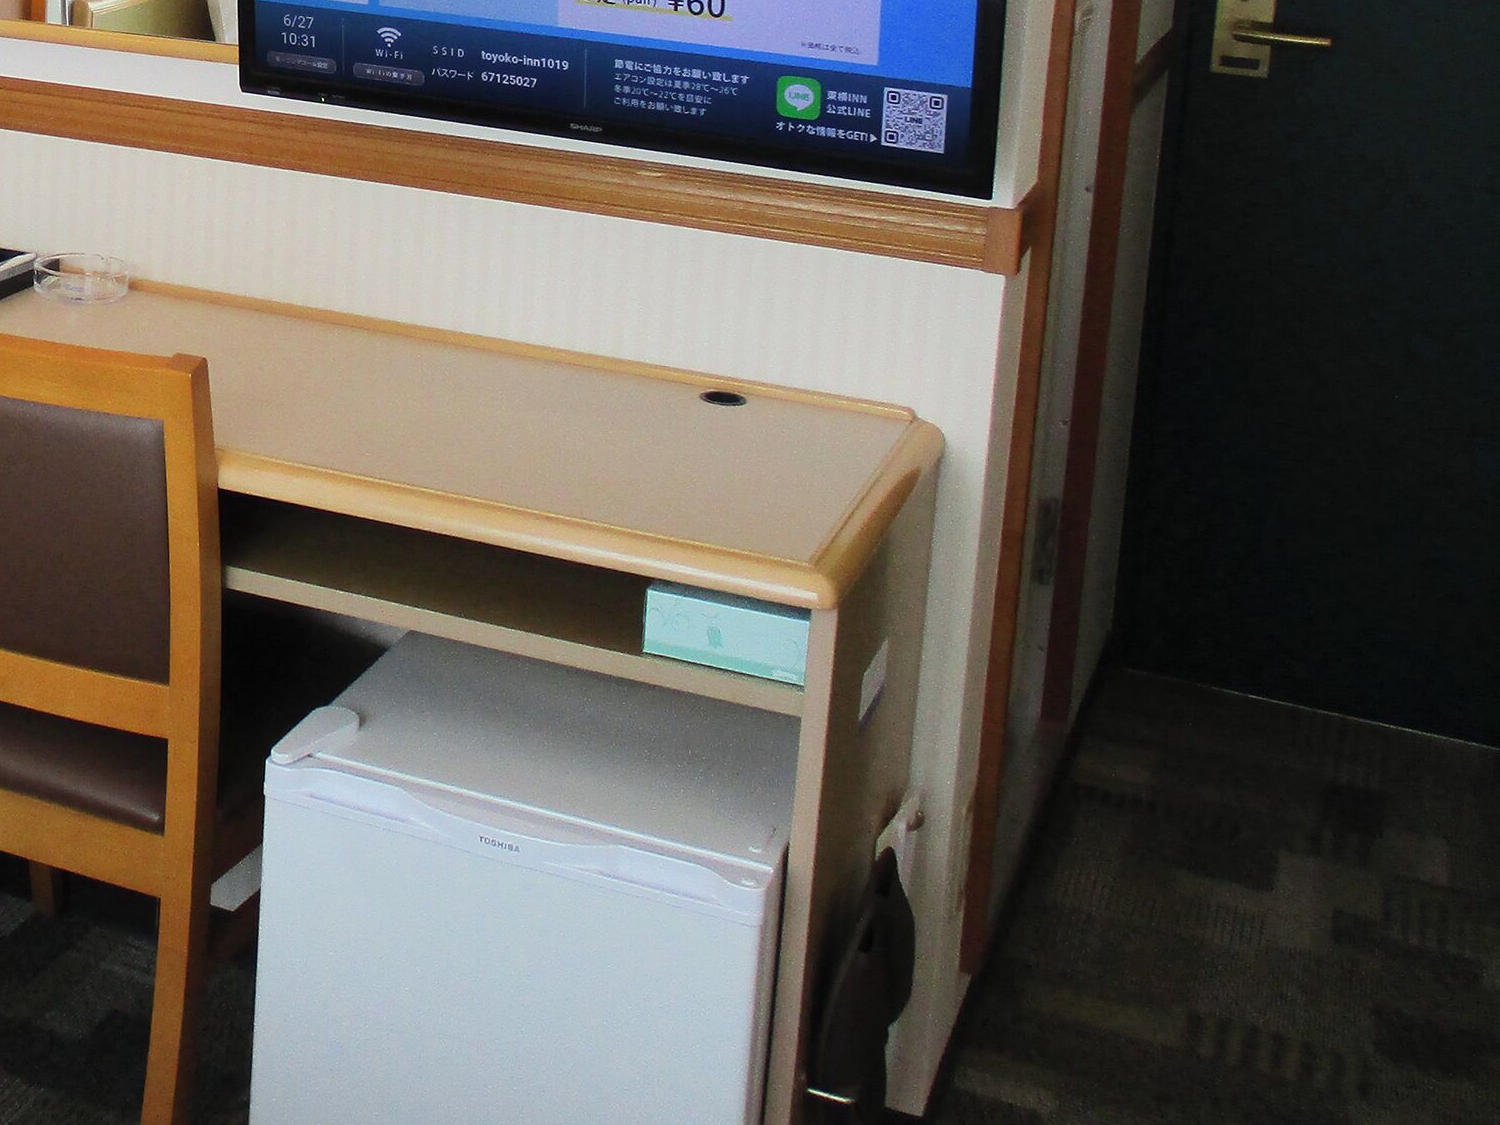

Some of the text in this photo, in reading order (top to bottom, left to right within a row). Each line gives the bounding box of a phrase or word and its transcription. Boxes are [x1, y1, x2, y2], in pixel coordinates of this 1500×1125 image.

[283, 13, 315, 30] 6/27
[281, 31, 316, 49] 10:31
[375, 48, 404, 60] Wi-Fi
[432, 44, 570, 72] SSID toyoko-inn1019
[431, 66, 538, 89] パスワード 67125027
[613, 59, 751, 86] 節電にご協力をお願い致します
[826, 90, 868, 105] 東横INN
[826, 104, 872, 119] 公式LINE
[569, 123, 604, 133] SHARP
[904, 116, 924, 125] LINE
[478, 835, 521, 853] TOSHIBA
